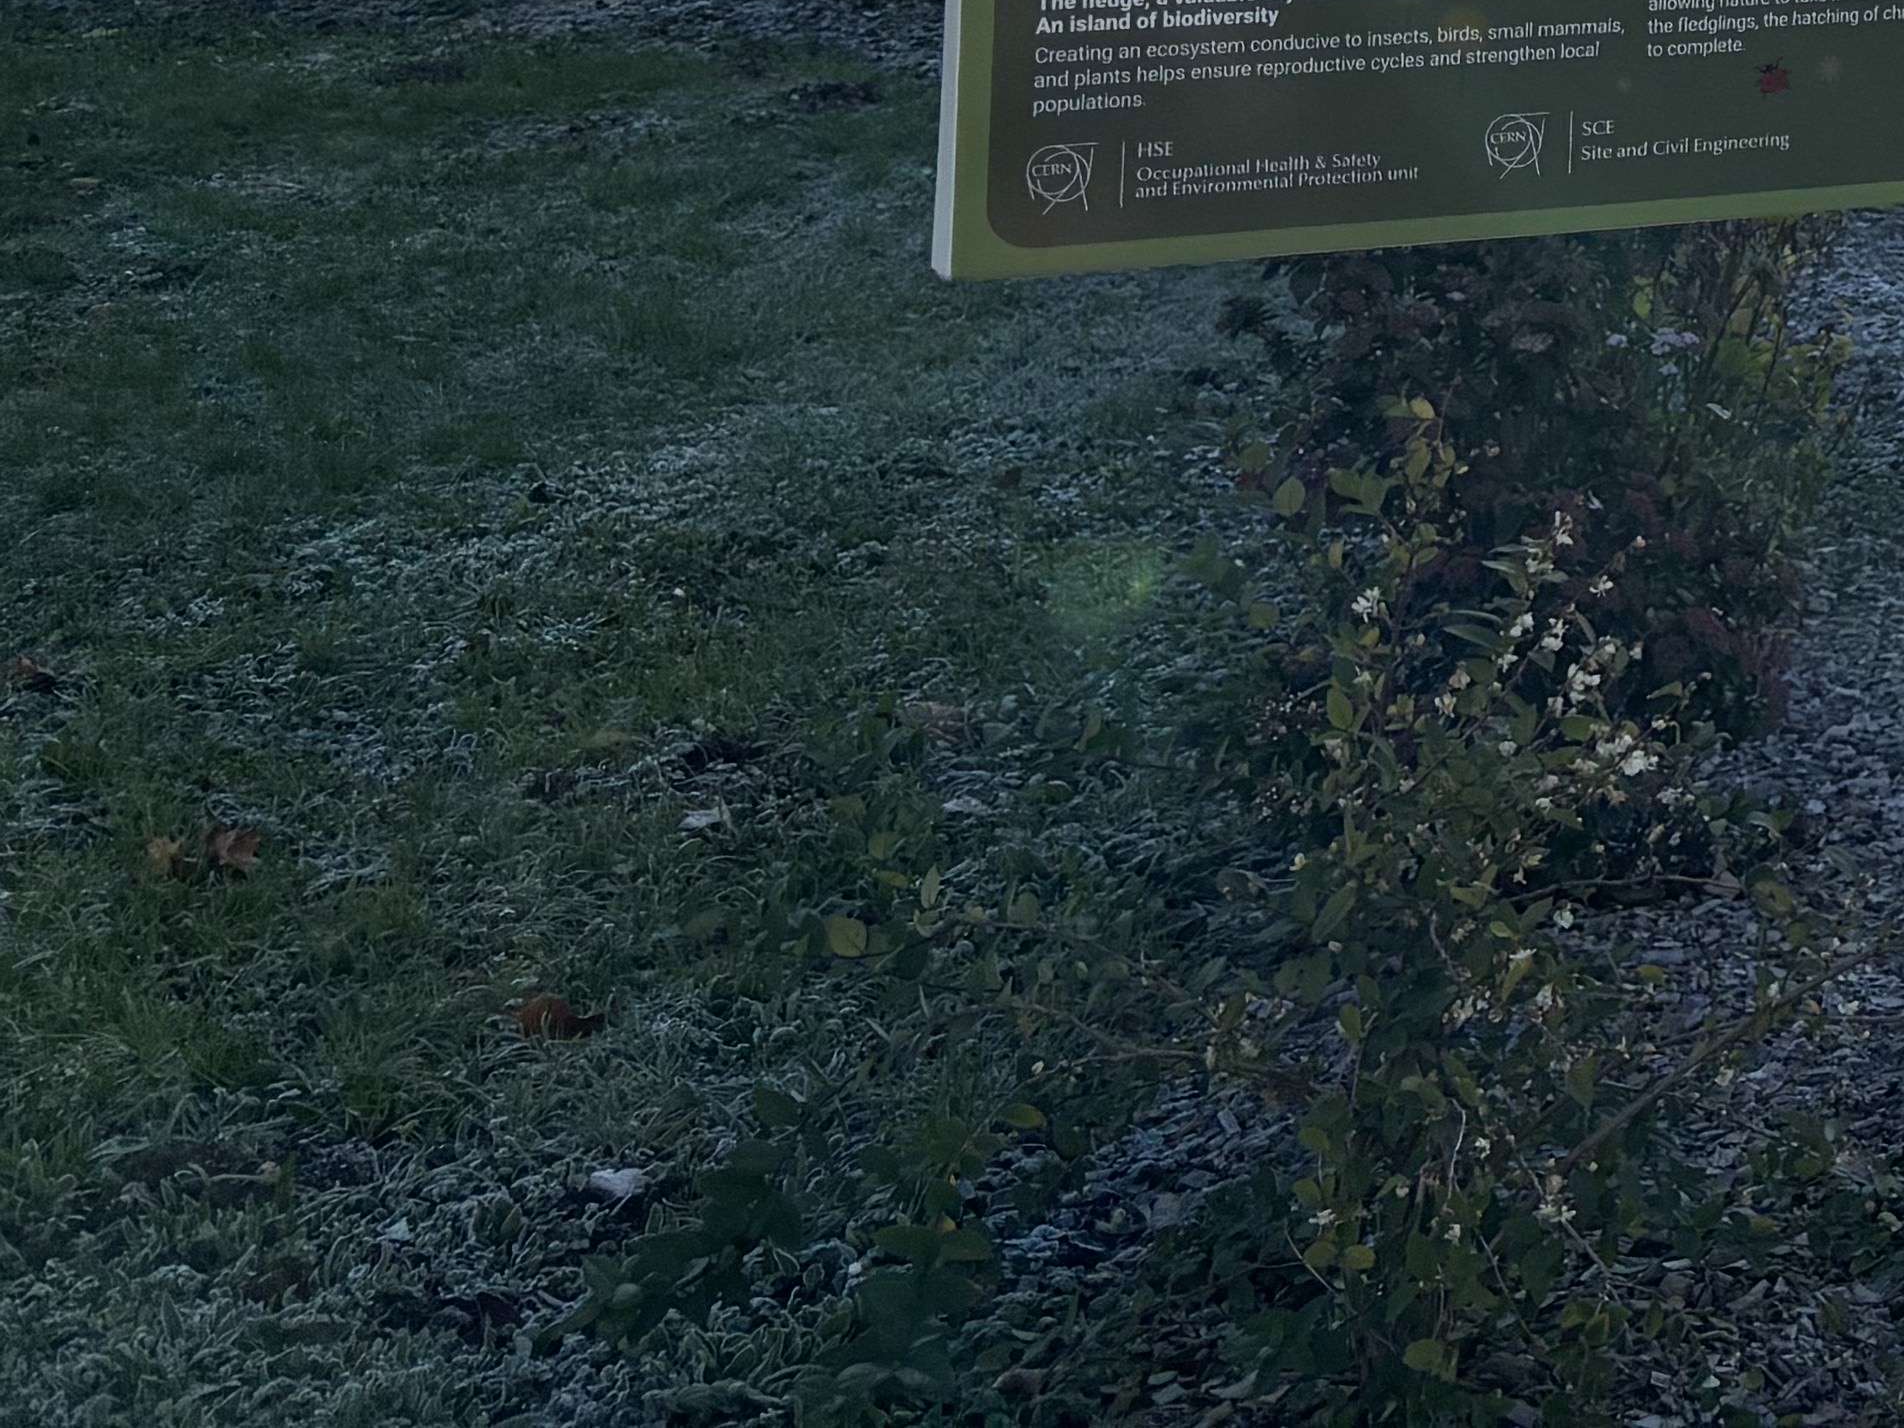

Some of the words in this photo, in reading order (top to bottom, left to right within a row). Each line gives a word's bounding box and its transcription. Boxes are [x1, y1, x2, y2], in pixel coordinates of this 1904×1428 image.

[1035, 17, 1063, 34] An
[1070, 12, 1130, 32] island
[1136, 11, 1157, 29] of
[1163, 6, 1279, 27] biodiversity
[1648, 44, 1663, 57] to
[1667, 38, 1746, 57] complete.
[1490, 131, 1527, 144] CERN
[1582, 120, 1614, 136] SCE
[1138, 141, 1174, 158] HSE
[1581, 143, 1612, 161] Site
[1617, 141, 1648, 158] and
[1653, 137, 1688, 155] Civil
[1694, 135, 1789, 155] Engineering
[1032, 163, 1072, 177] CERN
[1137, 159, 1250, 182] Occupational
[1256, 155, 1309, 173] Health
[1315, 156, 1326, 169] &
[1333, 154, 1380, 172] Safety
[1136, 181, 1167, 198] and
[1173, 173, 1293, 195] Environmental
[1299, 169, 1382, 186] Protection
[1388, 167, 1418, 180] unit
